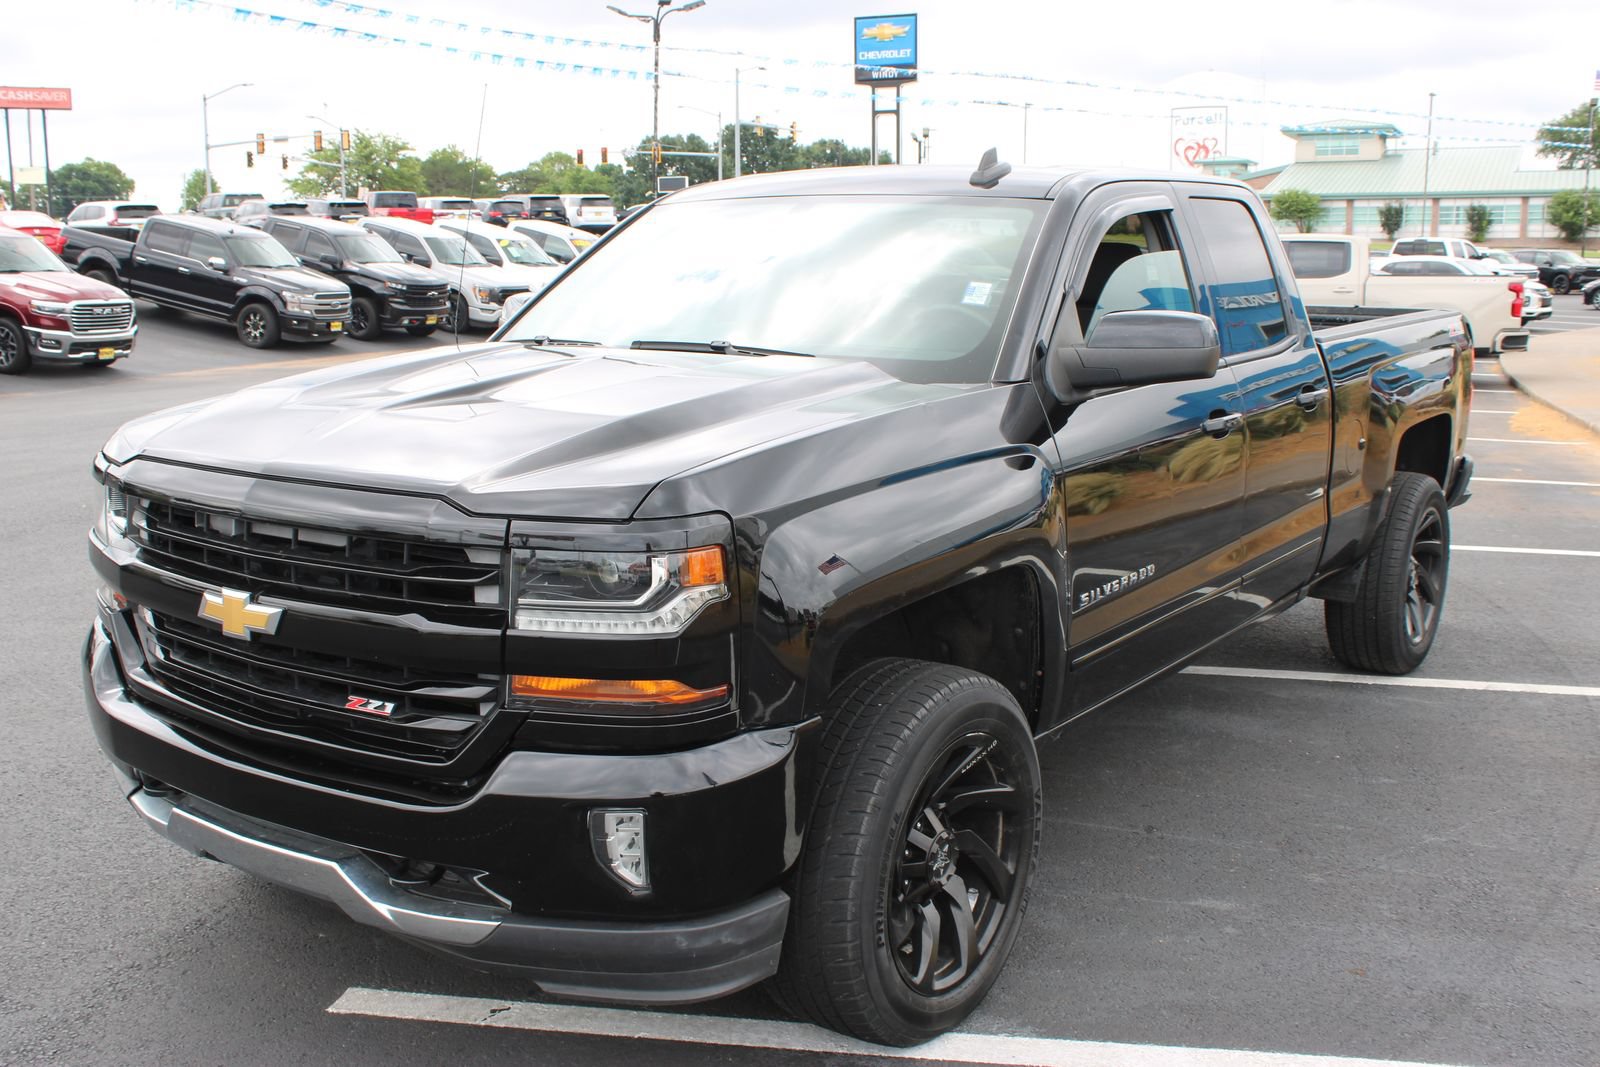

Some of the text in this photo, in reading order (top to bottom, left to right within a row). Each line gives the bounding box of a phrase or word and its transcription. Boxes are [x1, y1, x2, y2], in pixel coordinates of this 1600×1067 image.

[859, 49, 912, 60] CHEVROLET
[871, 70, 899, 79] WINDY
[1079, 563, 1156, 607] SILVERADO
[344, 695, 395, 716] Z71
